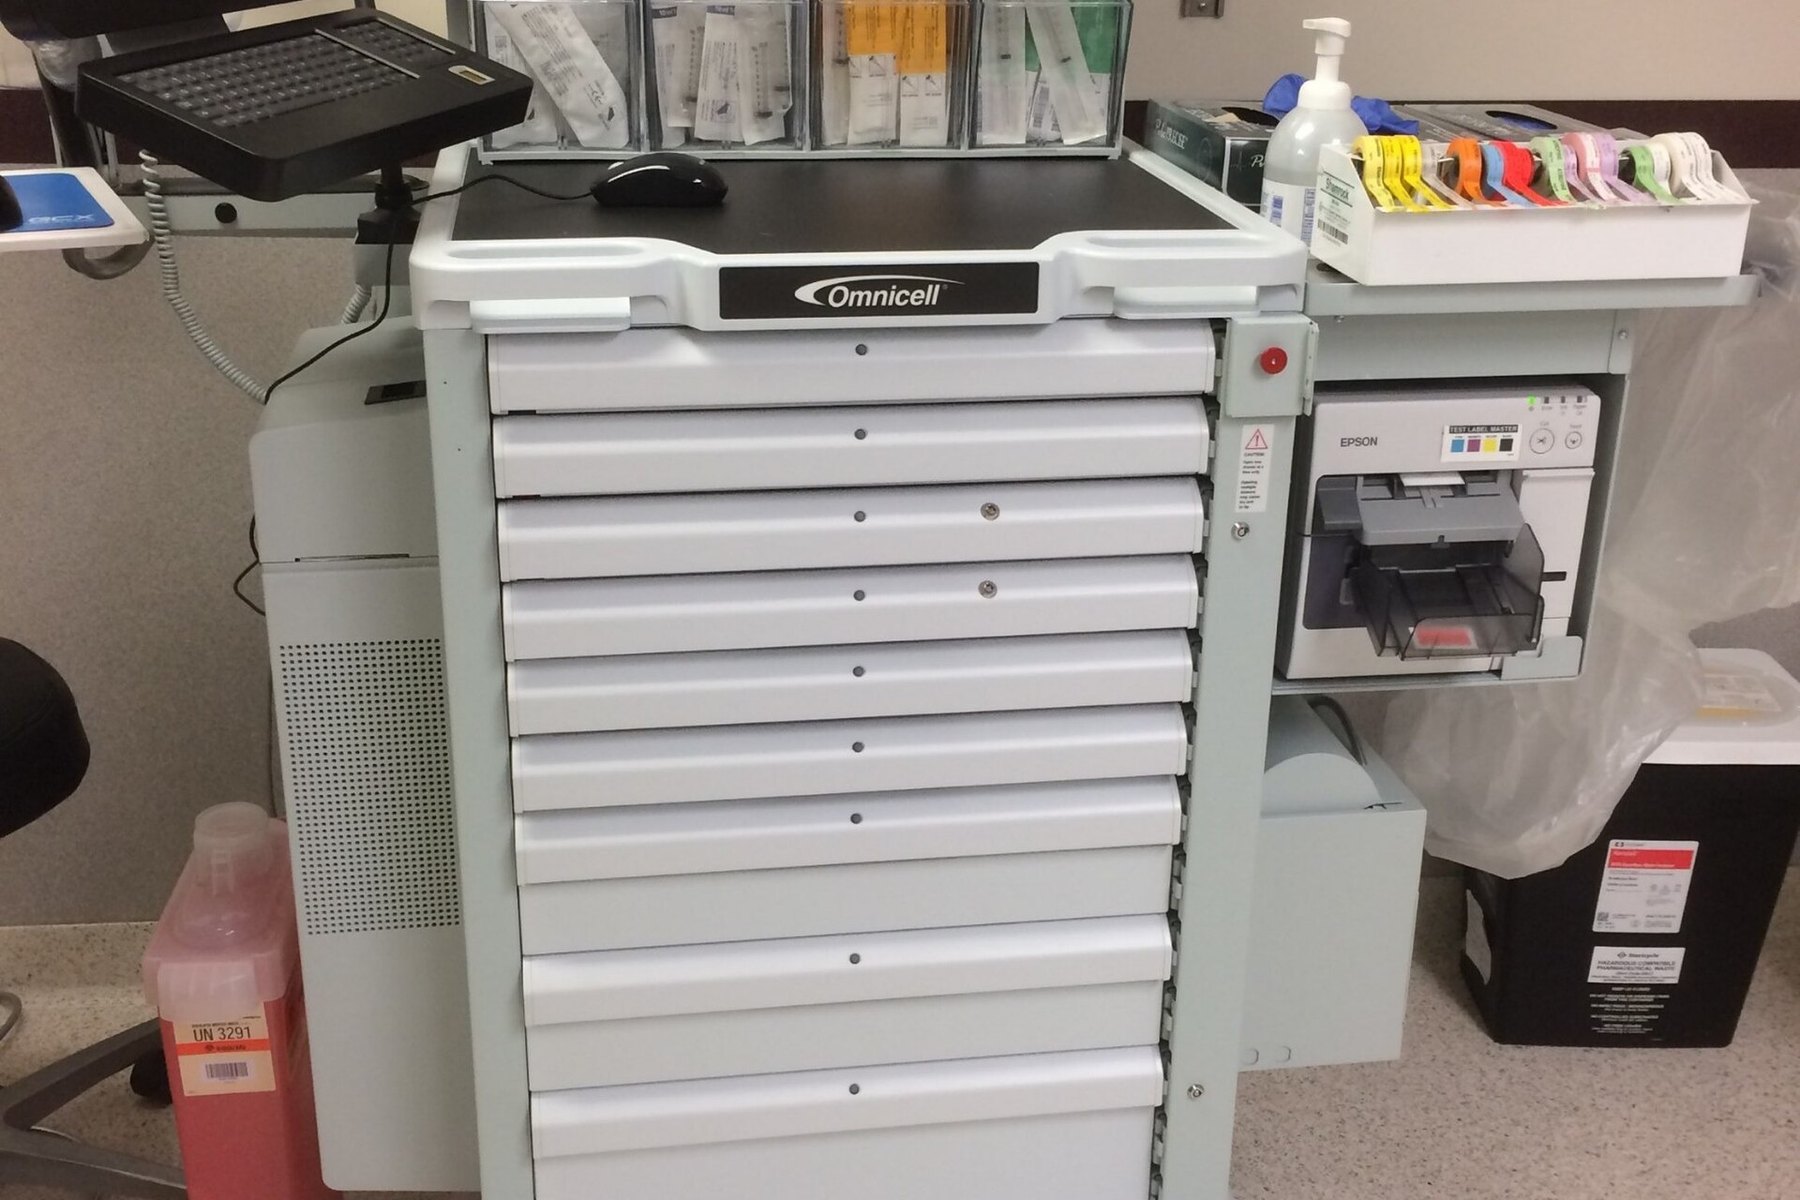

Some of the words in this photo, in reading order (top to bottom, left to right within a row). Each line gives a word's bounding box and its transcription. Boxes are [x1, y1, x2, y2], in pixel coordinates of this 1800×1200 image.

[828, 284, 940, 308] Omnicell
[1340, 437, 1378, 447] EPSON
[193, 1028, 214, 1042] UN
[217, 1026, 251, 1039] 3291
